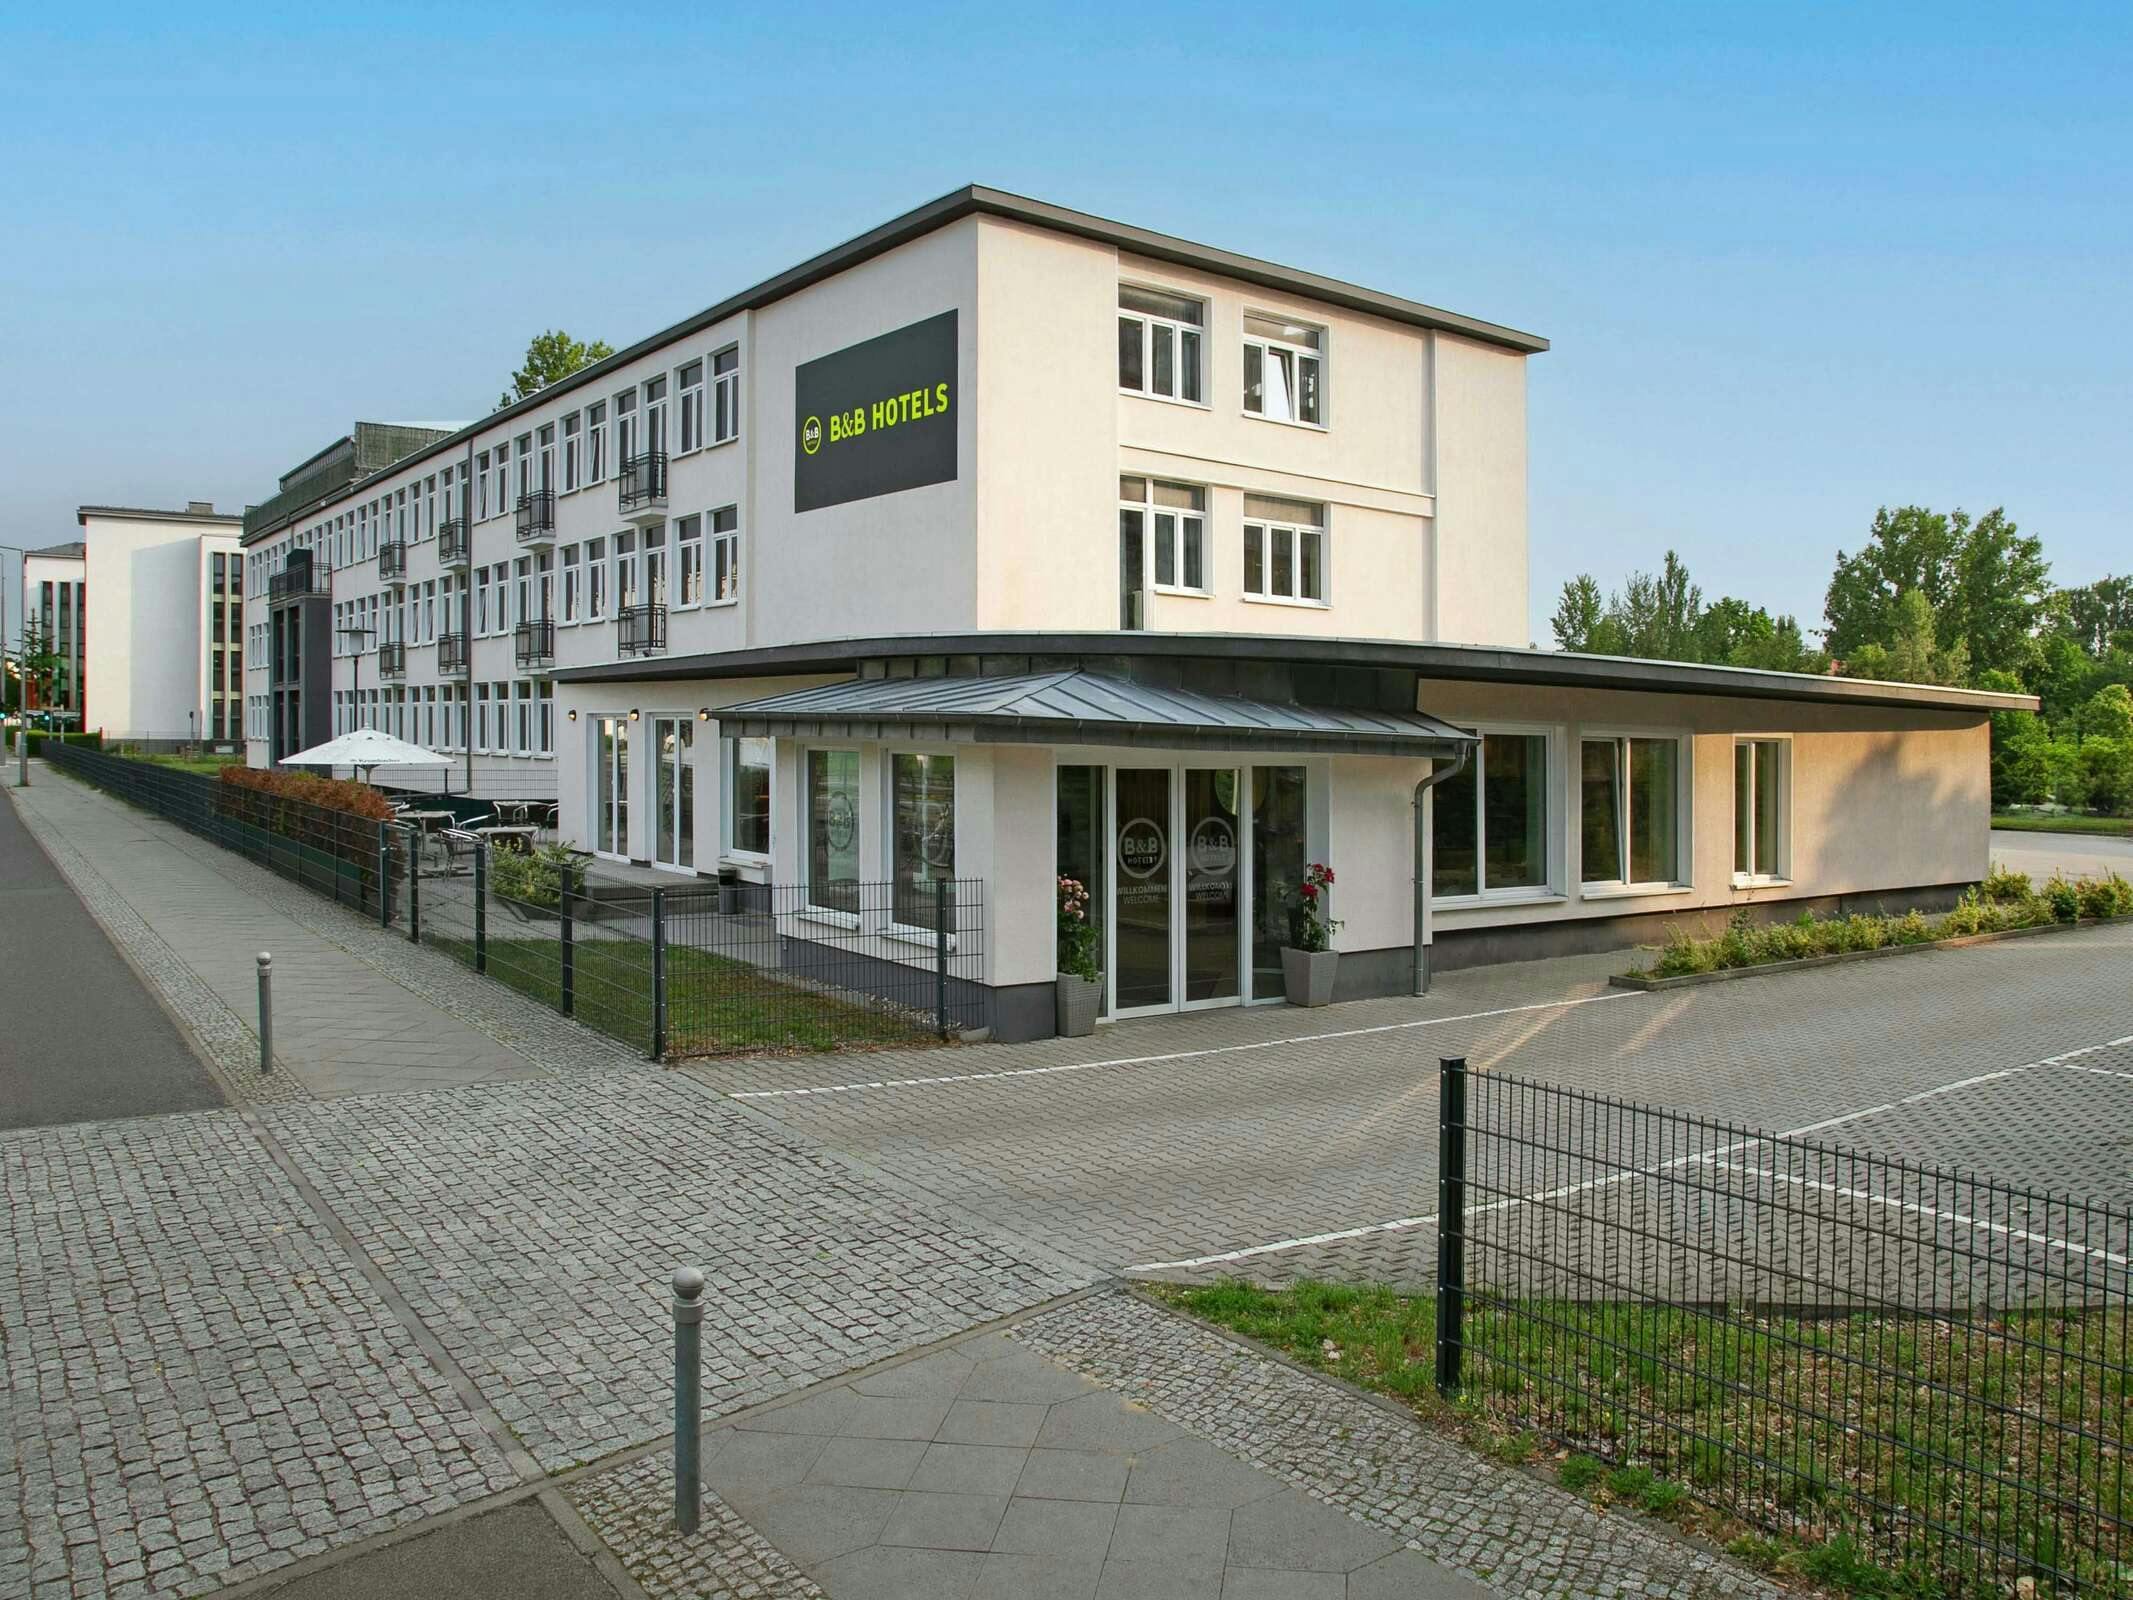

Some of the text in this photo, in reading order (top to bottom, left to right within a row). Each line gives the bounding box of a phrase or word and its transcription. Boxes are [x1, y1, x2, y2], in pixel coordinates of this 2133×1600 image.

[830, 383, 948, 442] B&B HOTELS
[806, 427, 819, 440] B&B
[1125, 837, 1158, 855] B&B
[1198, 835, 1228, 852] B&B
